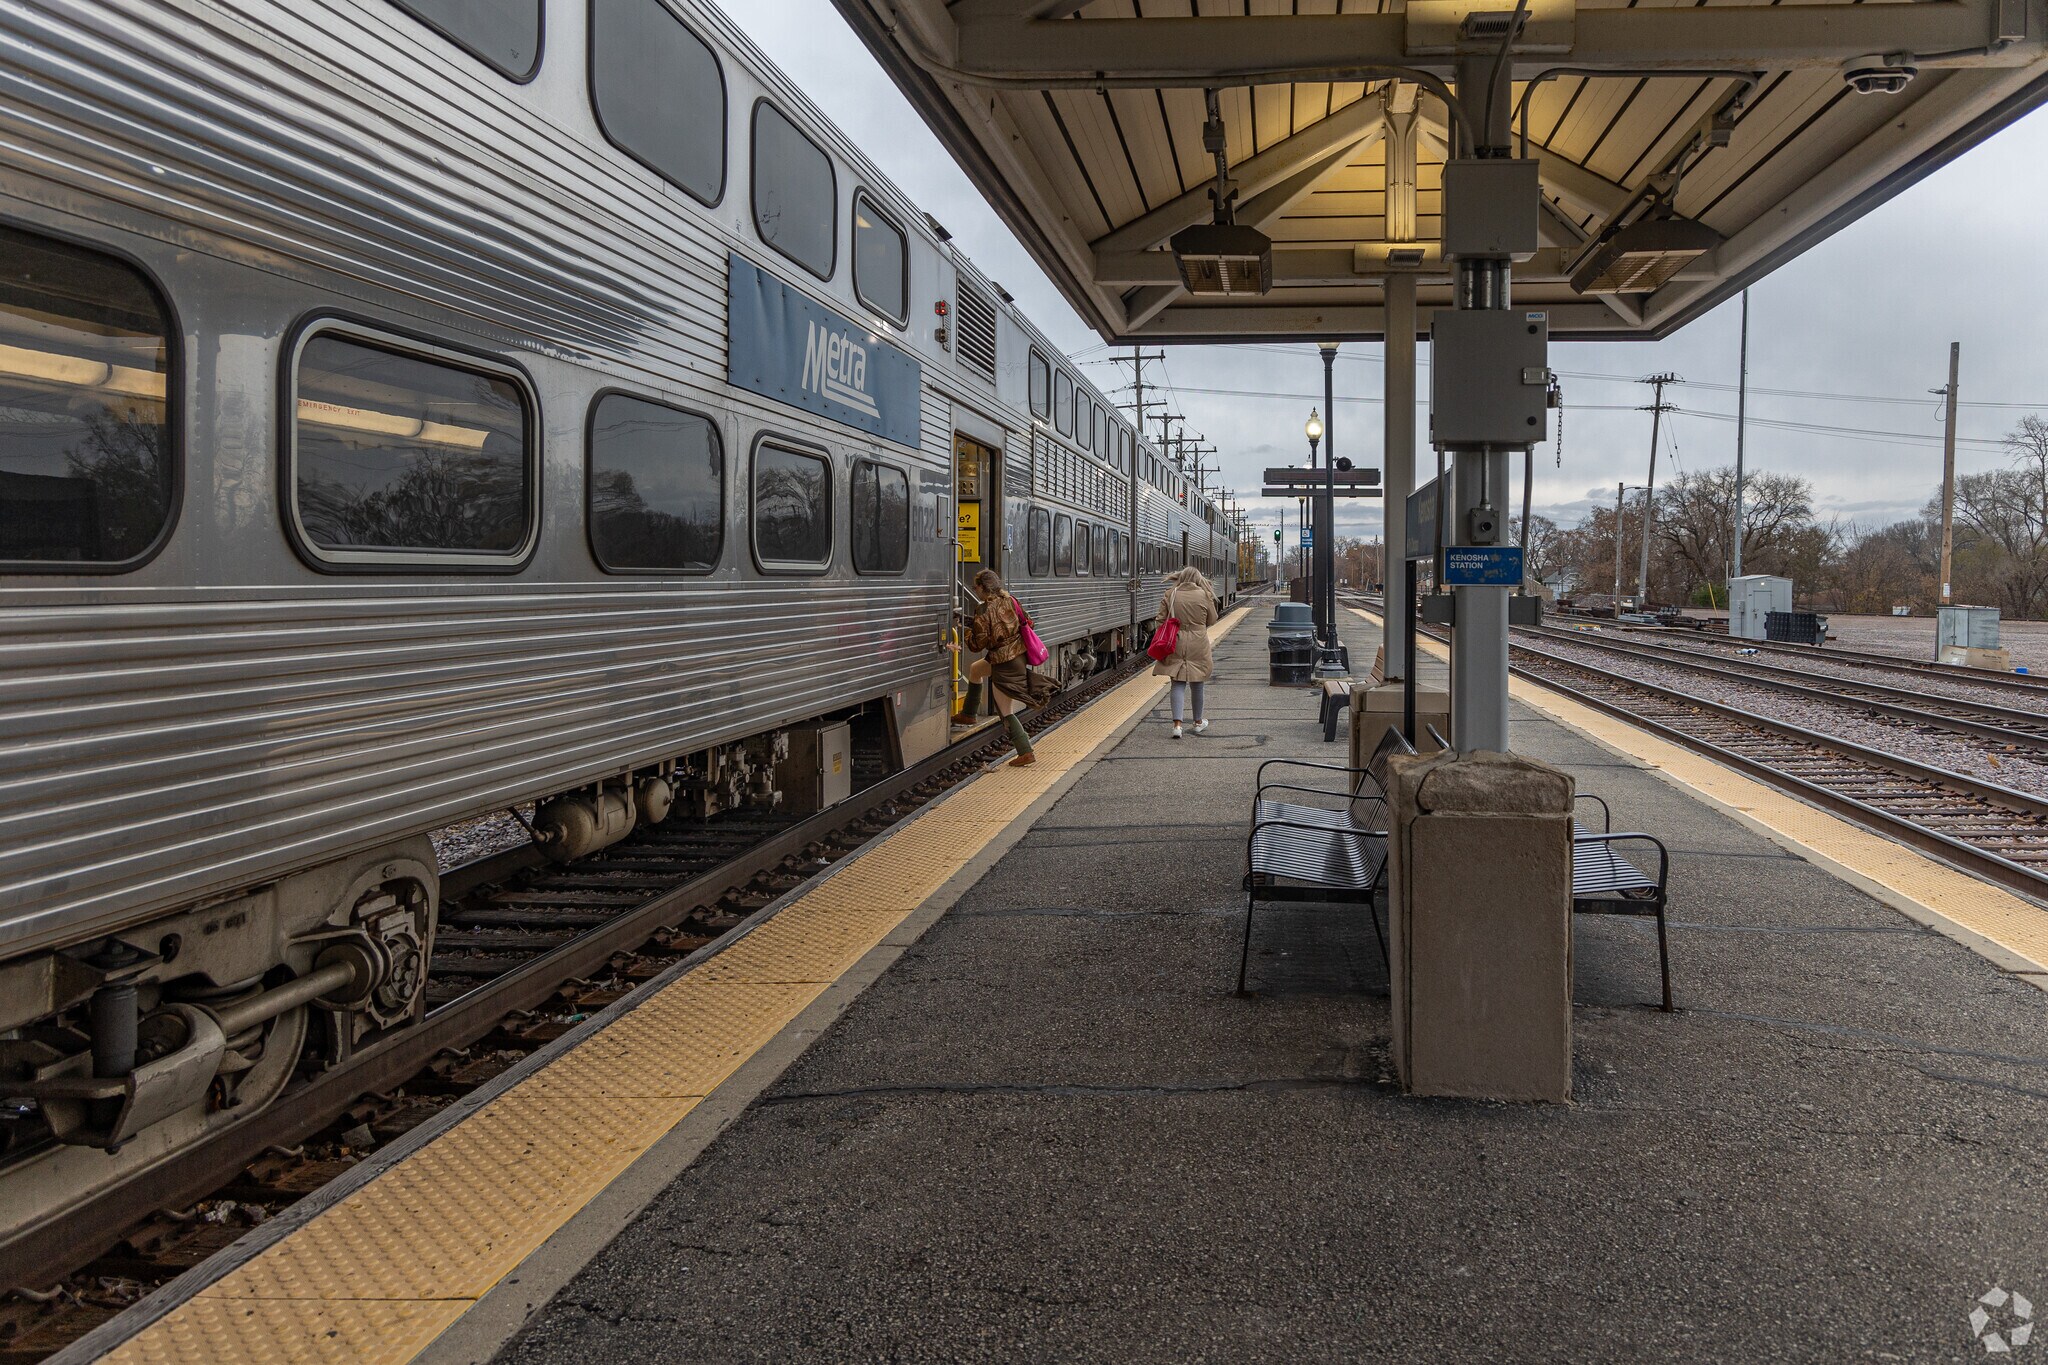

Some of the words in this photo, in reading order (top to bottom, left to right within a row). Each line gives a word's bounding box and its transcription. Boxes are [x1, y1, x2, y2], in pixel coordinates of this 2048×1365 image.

[802, 320, 868, 399] Metra
[298, 400, 340, 412] EMERGENCY
[1450, 554, 1489, 562] KENOSHA
